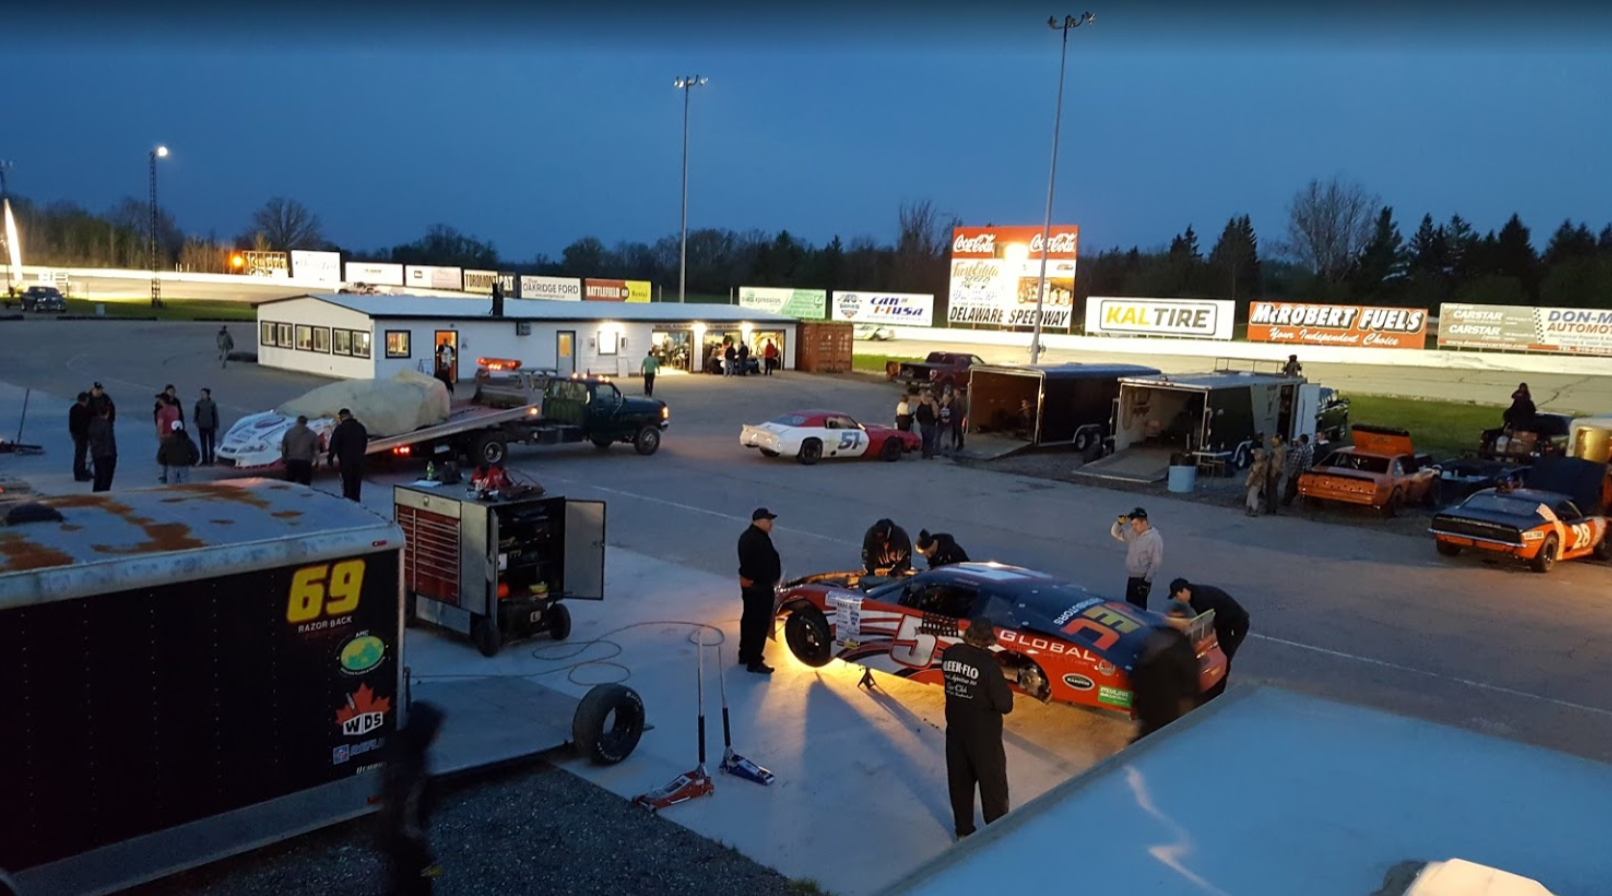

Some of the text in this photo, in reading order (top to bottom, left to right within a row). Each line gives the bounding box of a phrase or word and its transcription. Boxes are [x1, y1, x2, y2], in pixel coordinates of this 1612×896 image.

[953, 233, 996, 252] Coca-Cola
[522, 283, 579, 294] OAKRIDGE FORD
[949, 306, 1003, 322] DELAWARE
[1105, 306, 1210, 328] KAL TIRE
[1251, 304, 1423, 333] McROBERT FUELS
[1453, 310, 1503, 320] CARSTAR
[1269, 327, 1399, 346] Your Independent Choice
[1448, 324, 1502, 335] CARSTAR
[1571, 523, 1591, 550] 28
[286, 558, 366, 624] 69
[298, 616, 352, 633] RAZOR BACK
[890, 613, 937, 669] 5
[1000, 629, 1096, 662] GLOBAL
[345, 714, 382, 733] WDS
